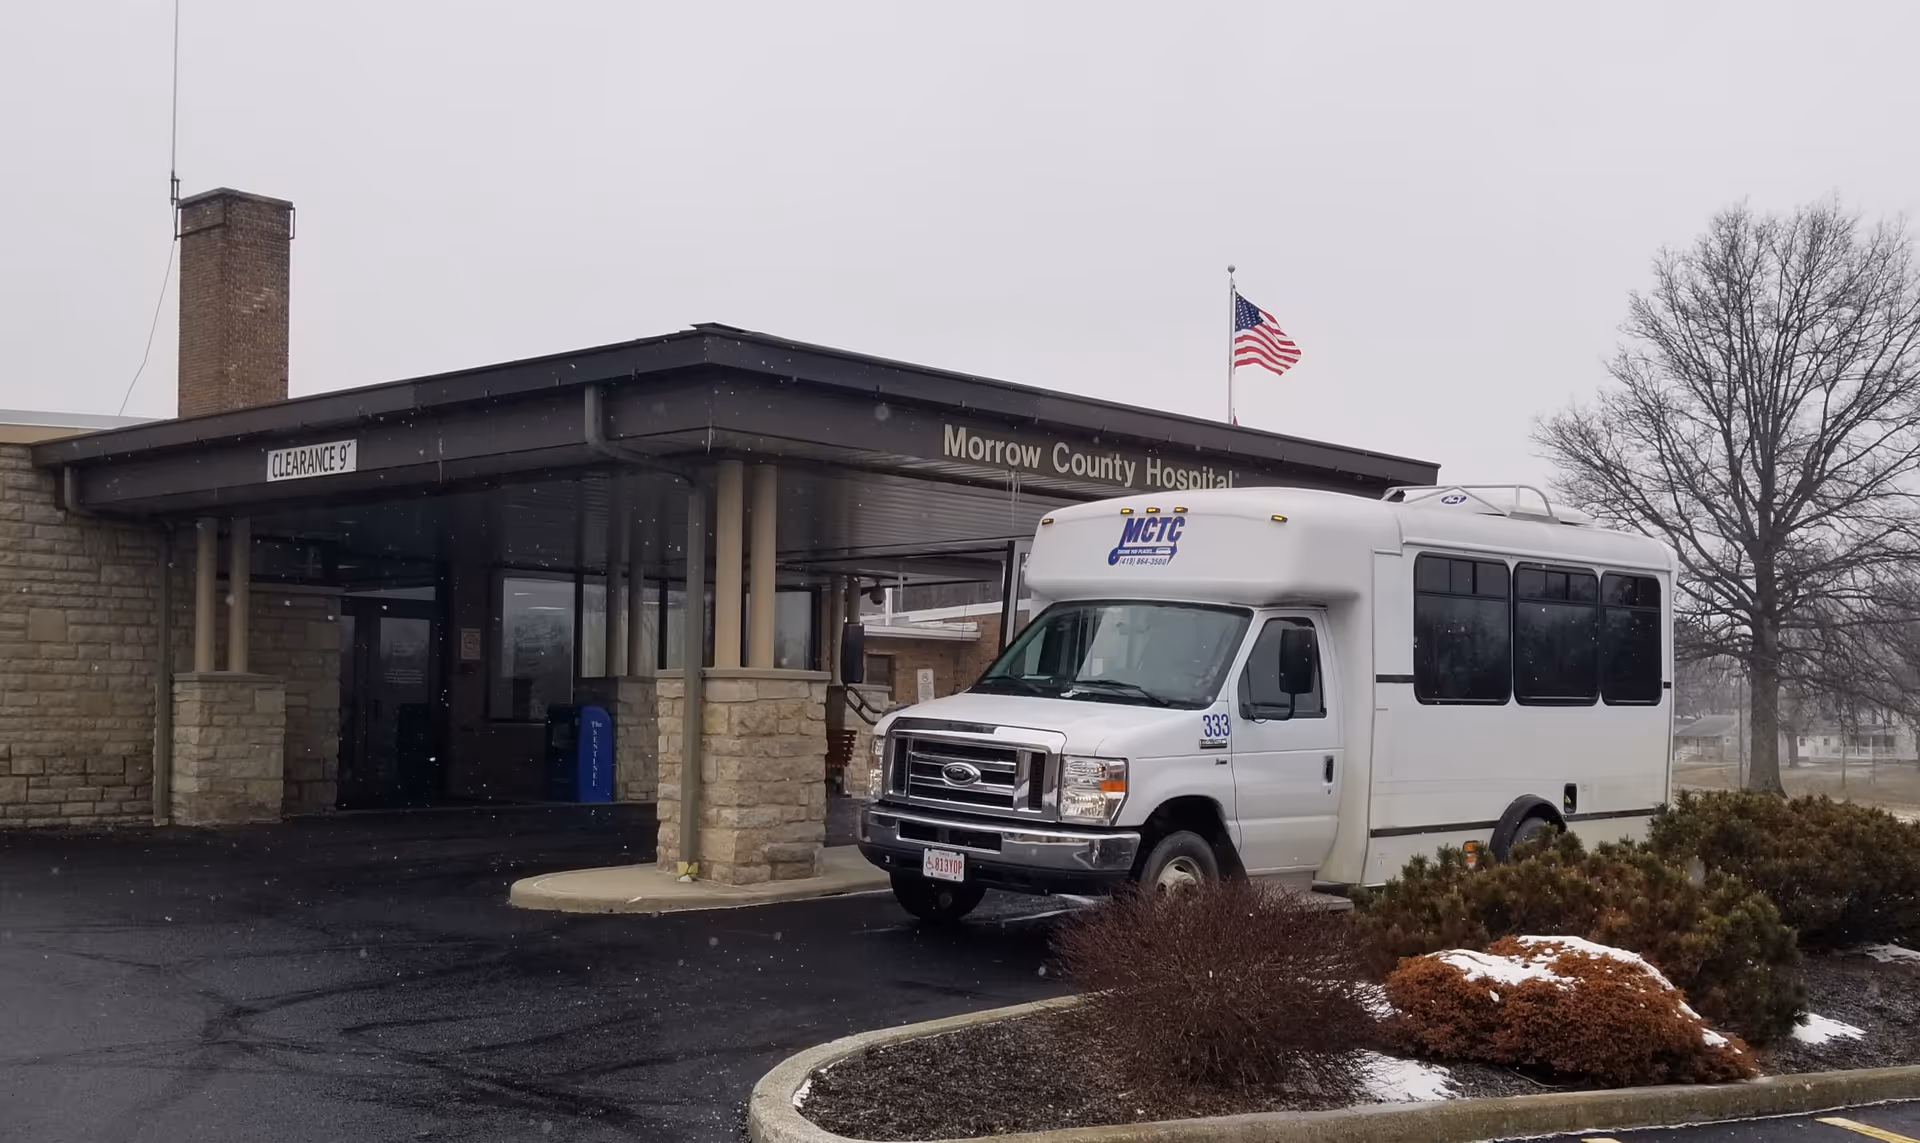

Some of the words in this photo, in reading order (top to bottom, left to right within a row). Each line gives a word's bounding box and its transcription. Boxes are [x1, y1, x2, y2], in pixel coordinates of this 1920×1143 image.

[272, 445, 336, 478] CLEARANCE
[943, 424, 1041, 468] Morrow
[1052, 442, 1136, 487] County
[1146, 457, 1233, 490] Hospital
[1120, 516, 1186, 543] MCTC
[1119, 557, 1136, 566] (419)
[591, 720, 603, 728] The
[1202, 713, 1230, 738] 333
